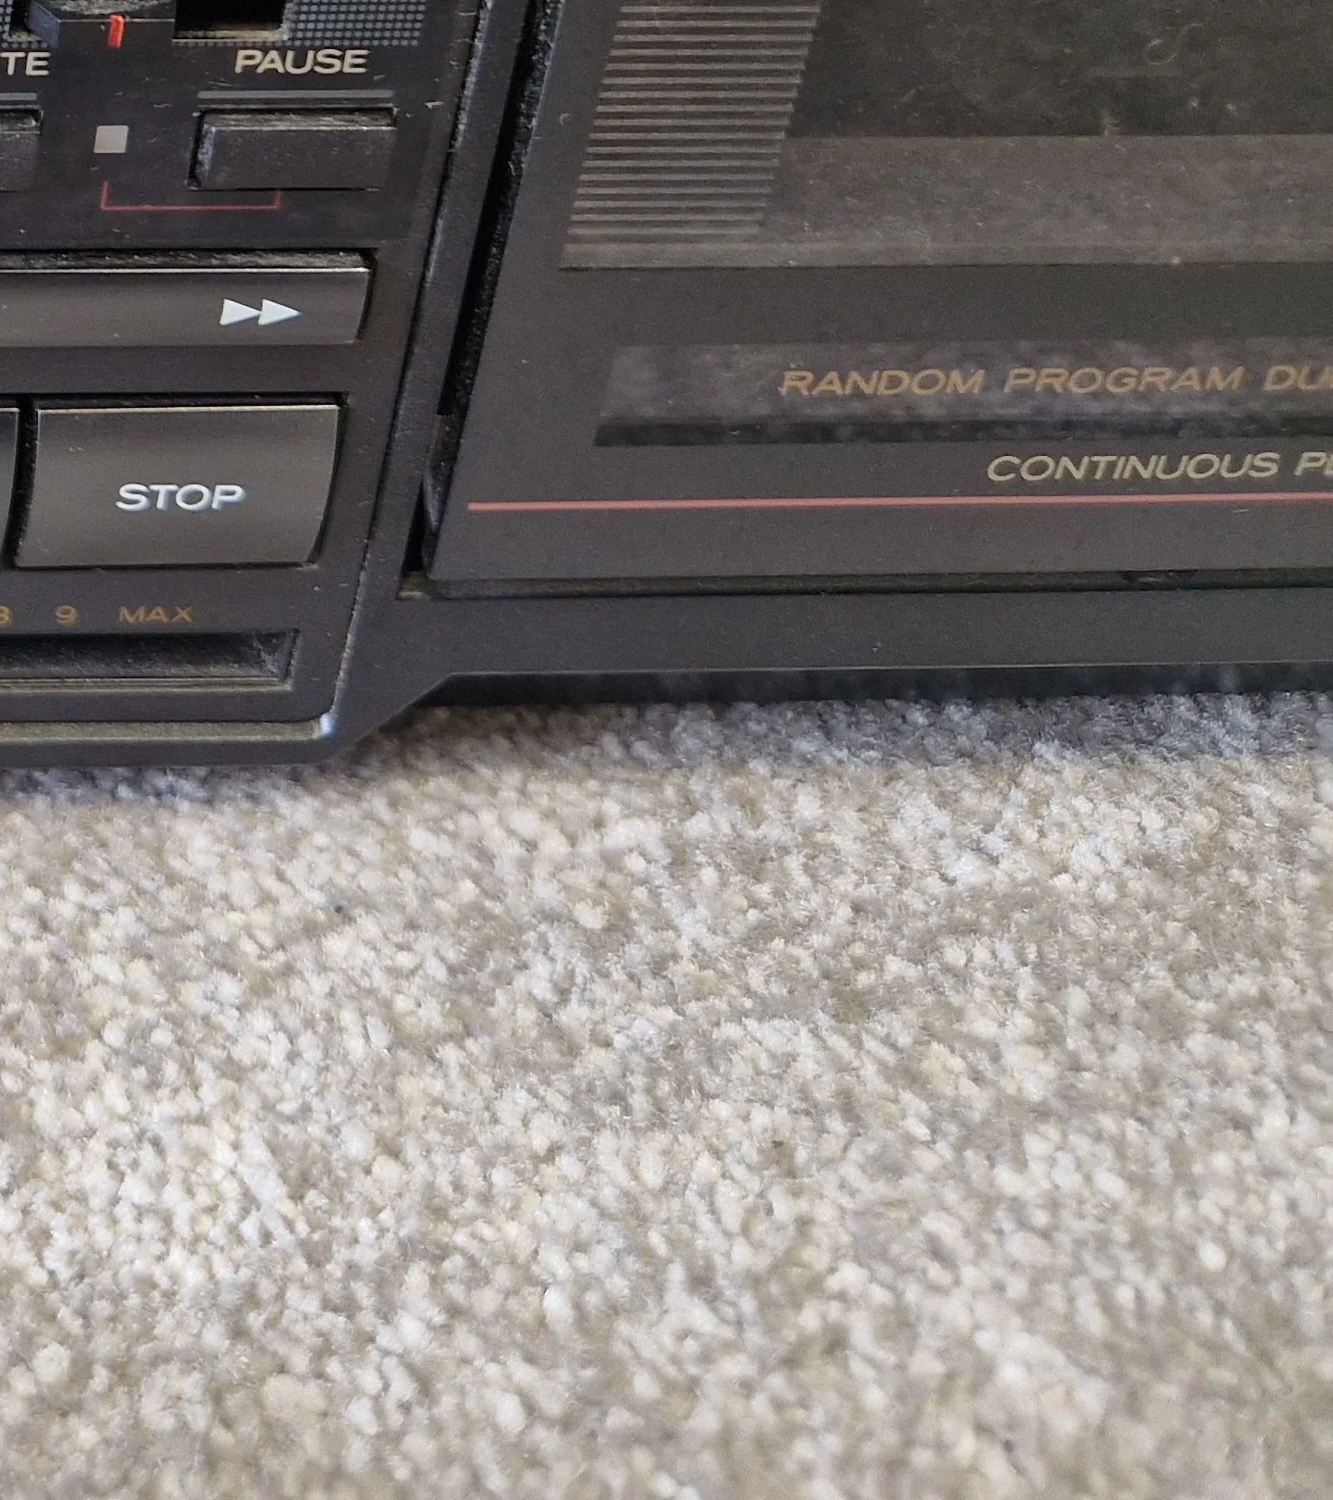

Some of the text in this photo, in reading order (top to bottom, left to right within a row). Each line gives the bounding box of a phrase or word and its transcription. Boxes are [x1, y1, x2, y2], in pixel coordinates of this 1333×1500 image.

[234, 49, 369, 75] PAUSE
[779, 368, 984, 397] RANDOM
[1003, 366, 1246, 395] PROGRAM
[986, 452, 1281, 481] CONTINUOUS
[116, 483, 245, 512] STOP
[54, 605, 78, 625] 9
[119, 604, 194, 625] MAX
